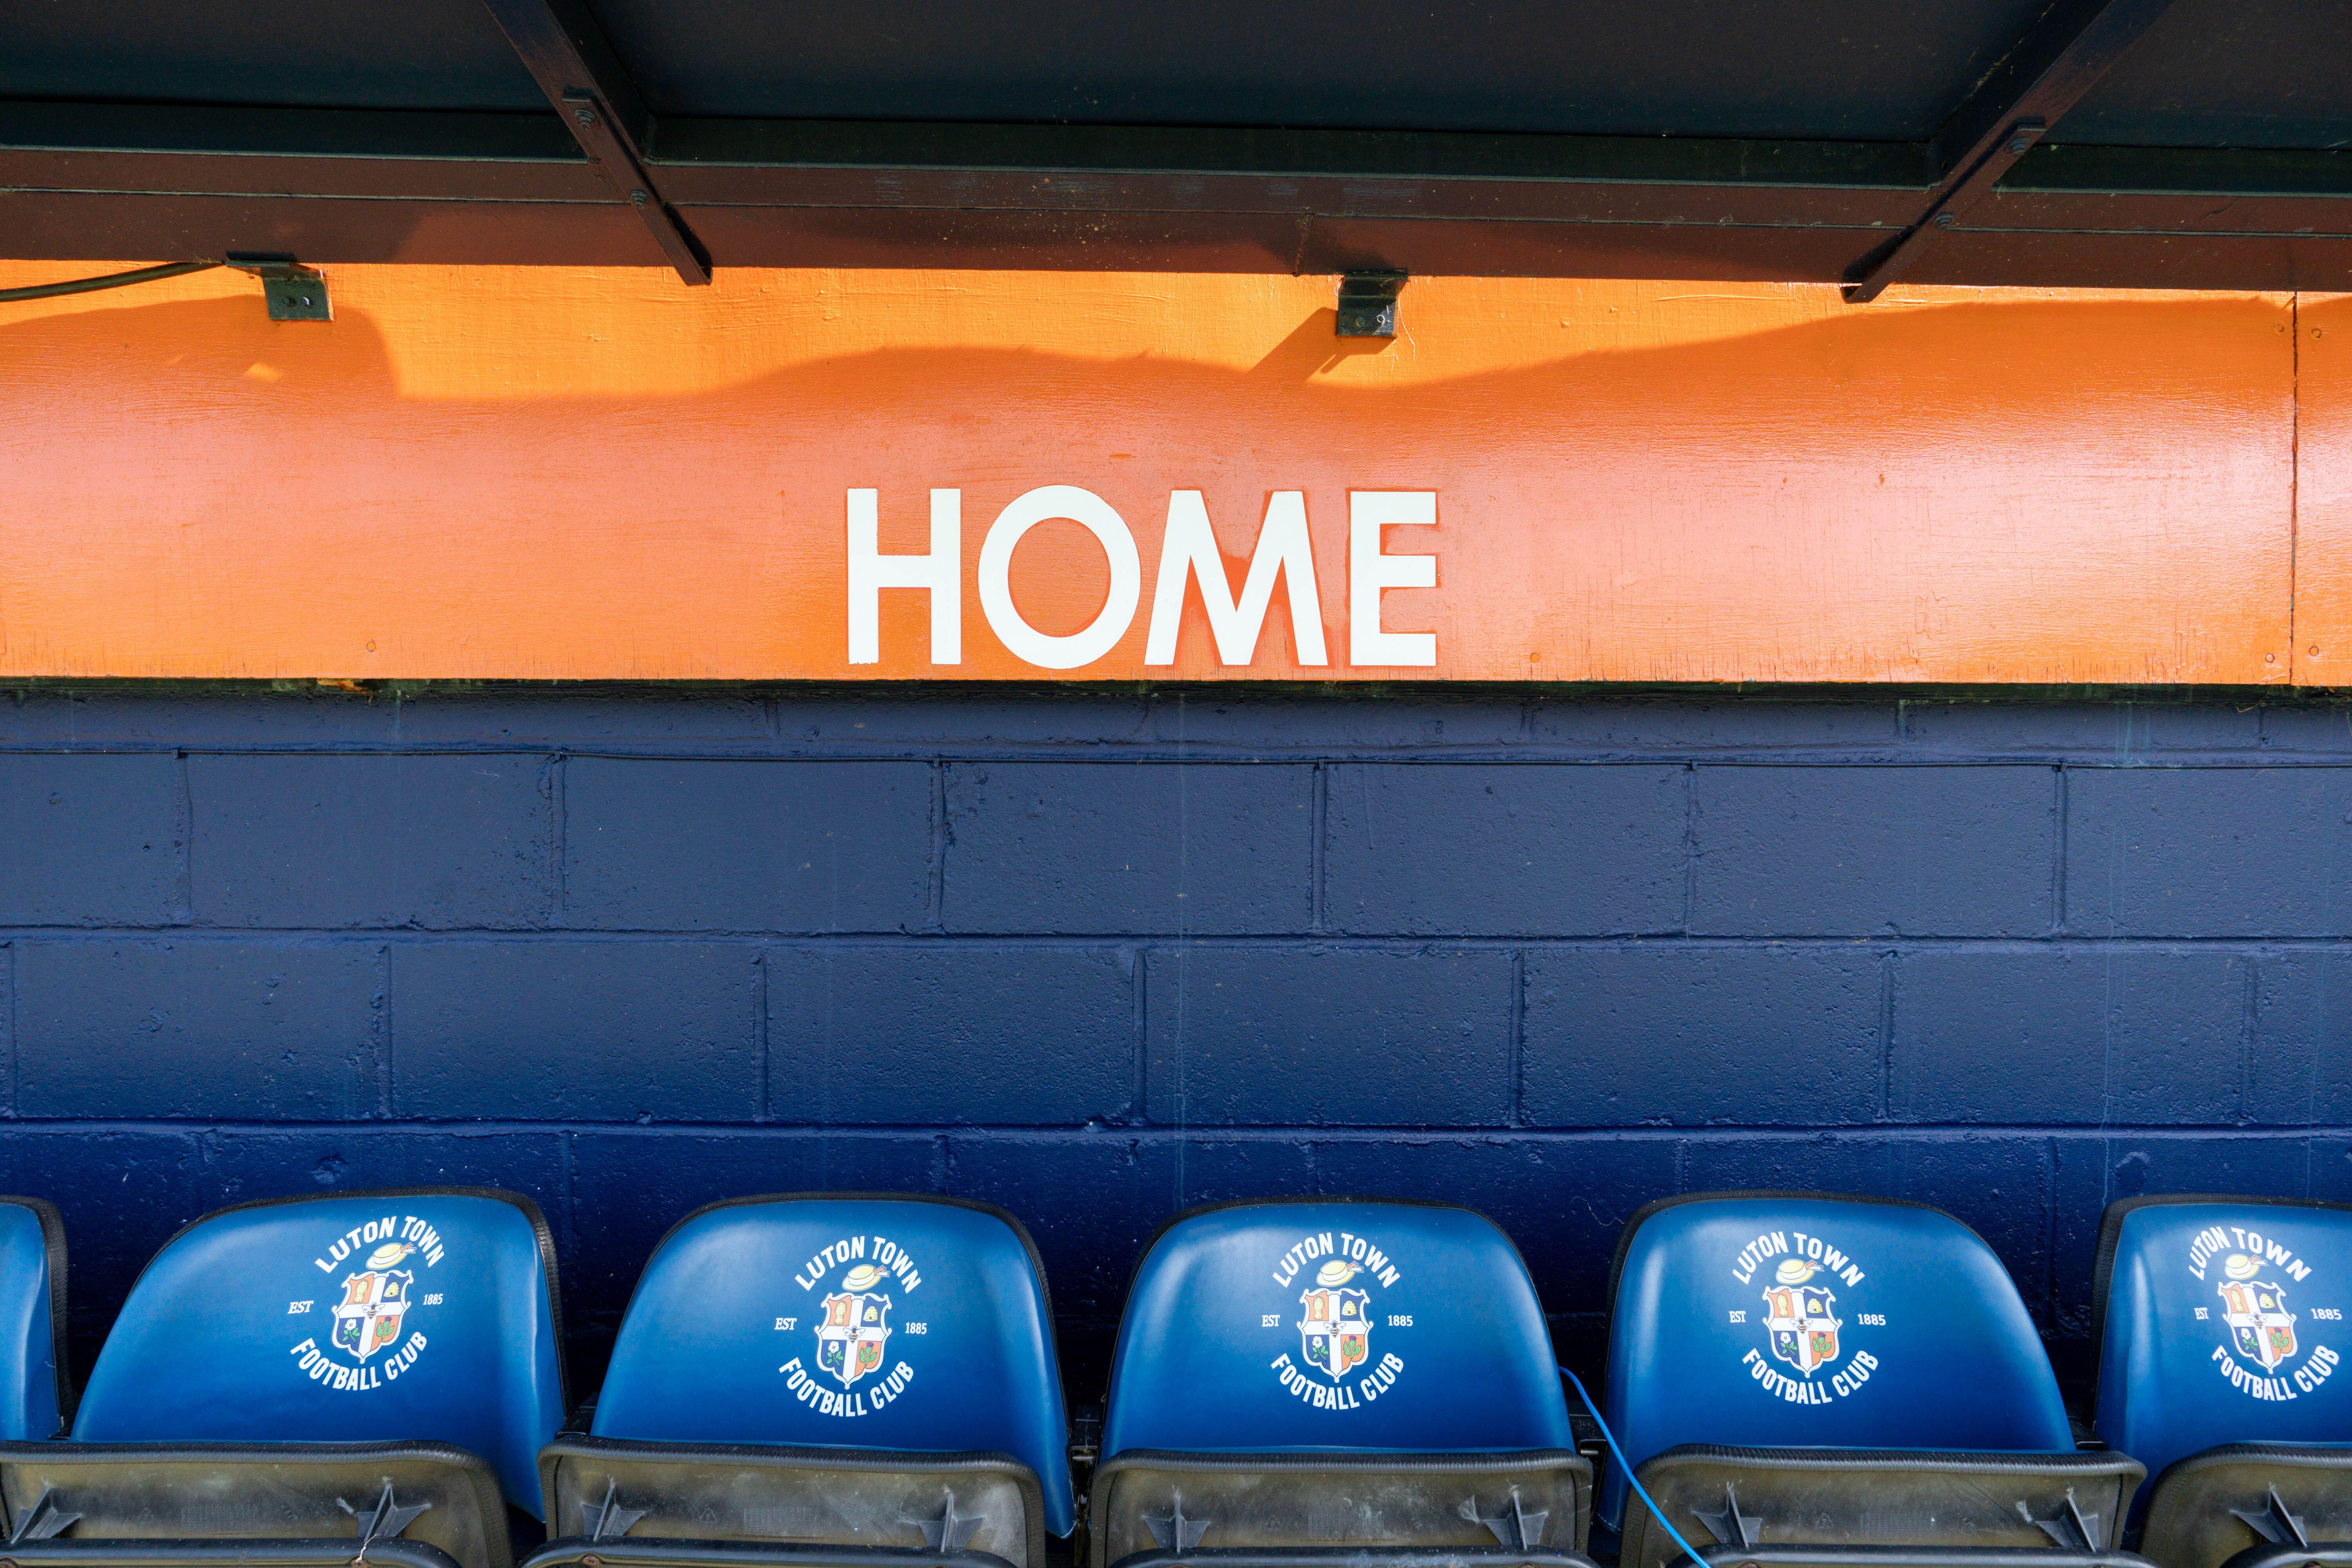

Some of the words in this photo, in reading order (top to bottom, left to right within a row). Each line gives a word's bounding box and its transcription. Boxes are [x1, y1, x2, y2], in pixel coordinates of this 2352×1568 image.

[847, 485, 1436, 669] HOME
[315, 1216, 397, 1274] LUTON
[401, 1216, 444, 1267] TOWN
[795, 1236, 865, 1291] LUTON
[872, 1236, 921, 1294] TOWN
[1272, 1232, 1334, 1288] LUTON
[1341, 1233, 1401, 1289] TOWN
[1733, 1231, 1789, 1285] LUTON
[1793, 1232, 1865, 1287] TOWN
[2189, 1226, 2231, 1281] LUTON
[2230, 1227, 2312, 1282] TOWN
[287, 1300, 314, 1314] EST
[423, 1293, 443, 1305] 1885
[774, 1318, 797, 1330] EST
[906, 1322, 927, 1334] 1885
[1261, 1314, 1280, 1327] EST
[1388, 1315, 1413, 1327] 1885
[1729, 1310, 1746, 1323] EST
[1858, 1314, 1886, 1325] 1885
[2194, 1307, 2209, 1319] EST
[2311, 1308, 2342, 1320] 1885
[290, 1338, 381, 1390] FOOTBALL
[385, 1332, 427, 1380] CLUB
[779, 1357, 867, 1417] FOOTBALL
[870, 1361, 913, 1409] CLUB
[1271, 1353, 1360, 1410] FOOTBALL
[1360, 1353, 1403, 1401] CLUB
[1742, 1348, 1832, 1404] FOOTBALL
[1833, 1350, 1878, 1396] CLUB
[2212, 1345, 2297, 1401] FOOTBALL
[2294, 1345, 2339, 1392] CLUB
